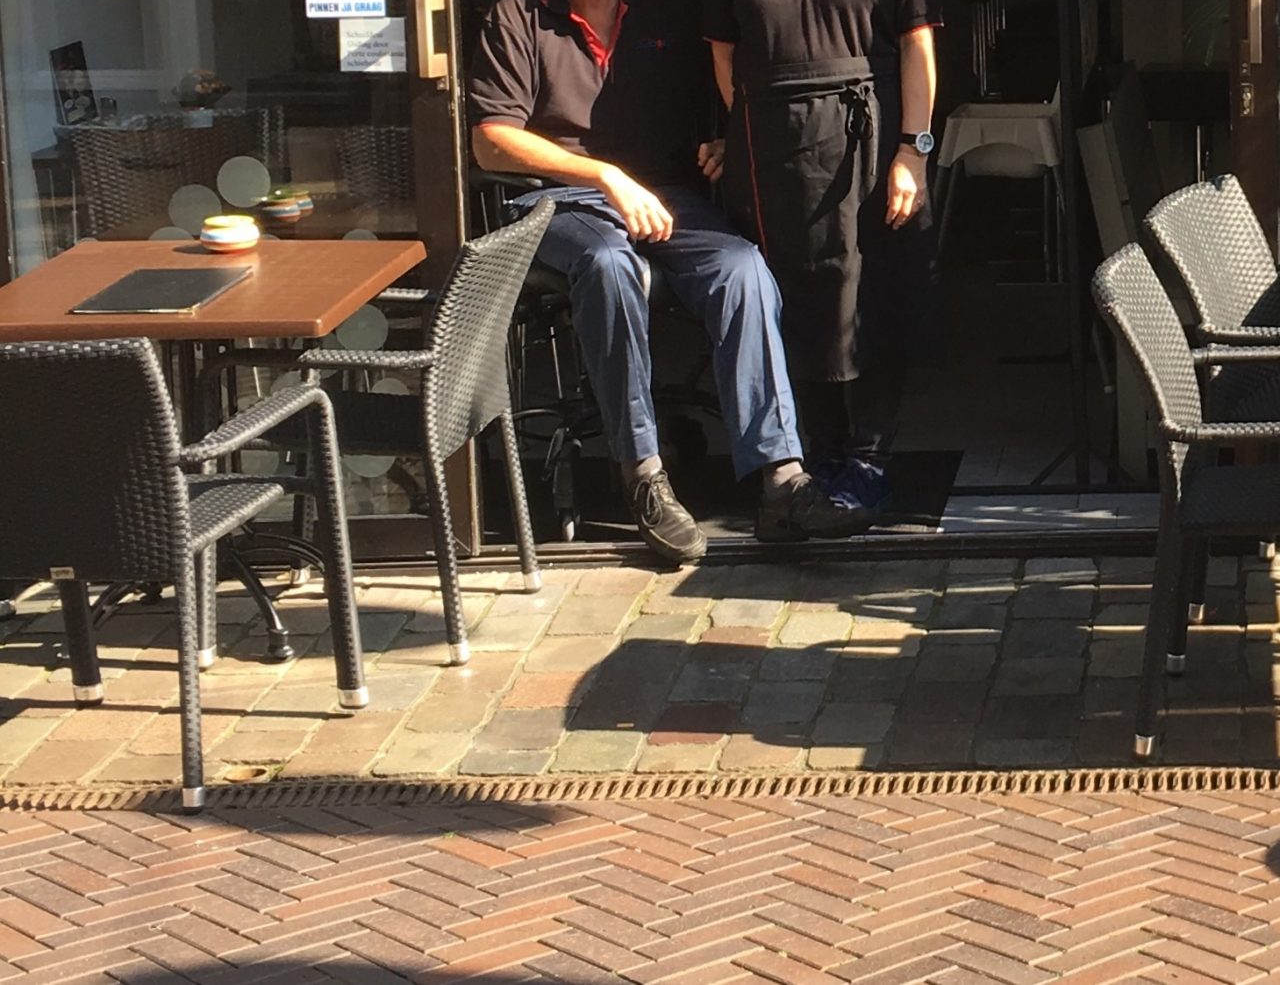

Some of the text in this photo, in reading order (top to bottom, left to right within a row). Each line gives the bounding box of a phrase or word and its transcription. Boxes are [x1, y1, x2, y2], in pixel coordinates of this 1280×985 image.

[308, 2, 383, 13] PINNEN JA GRAAG
